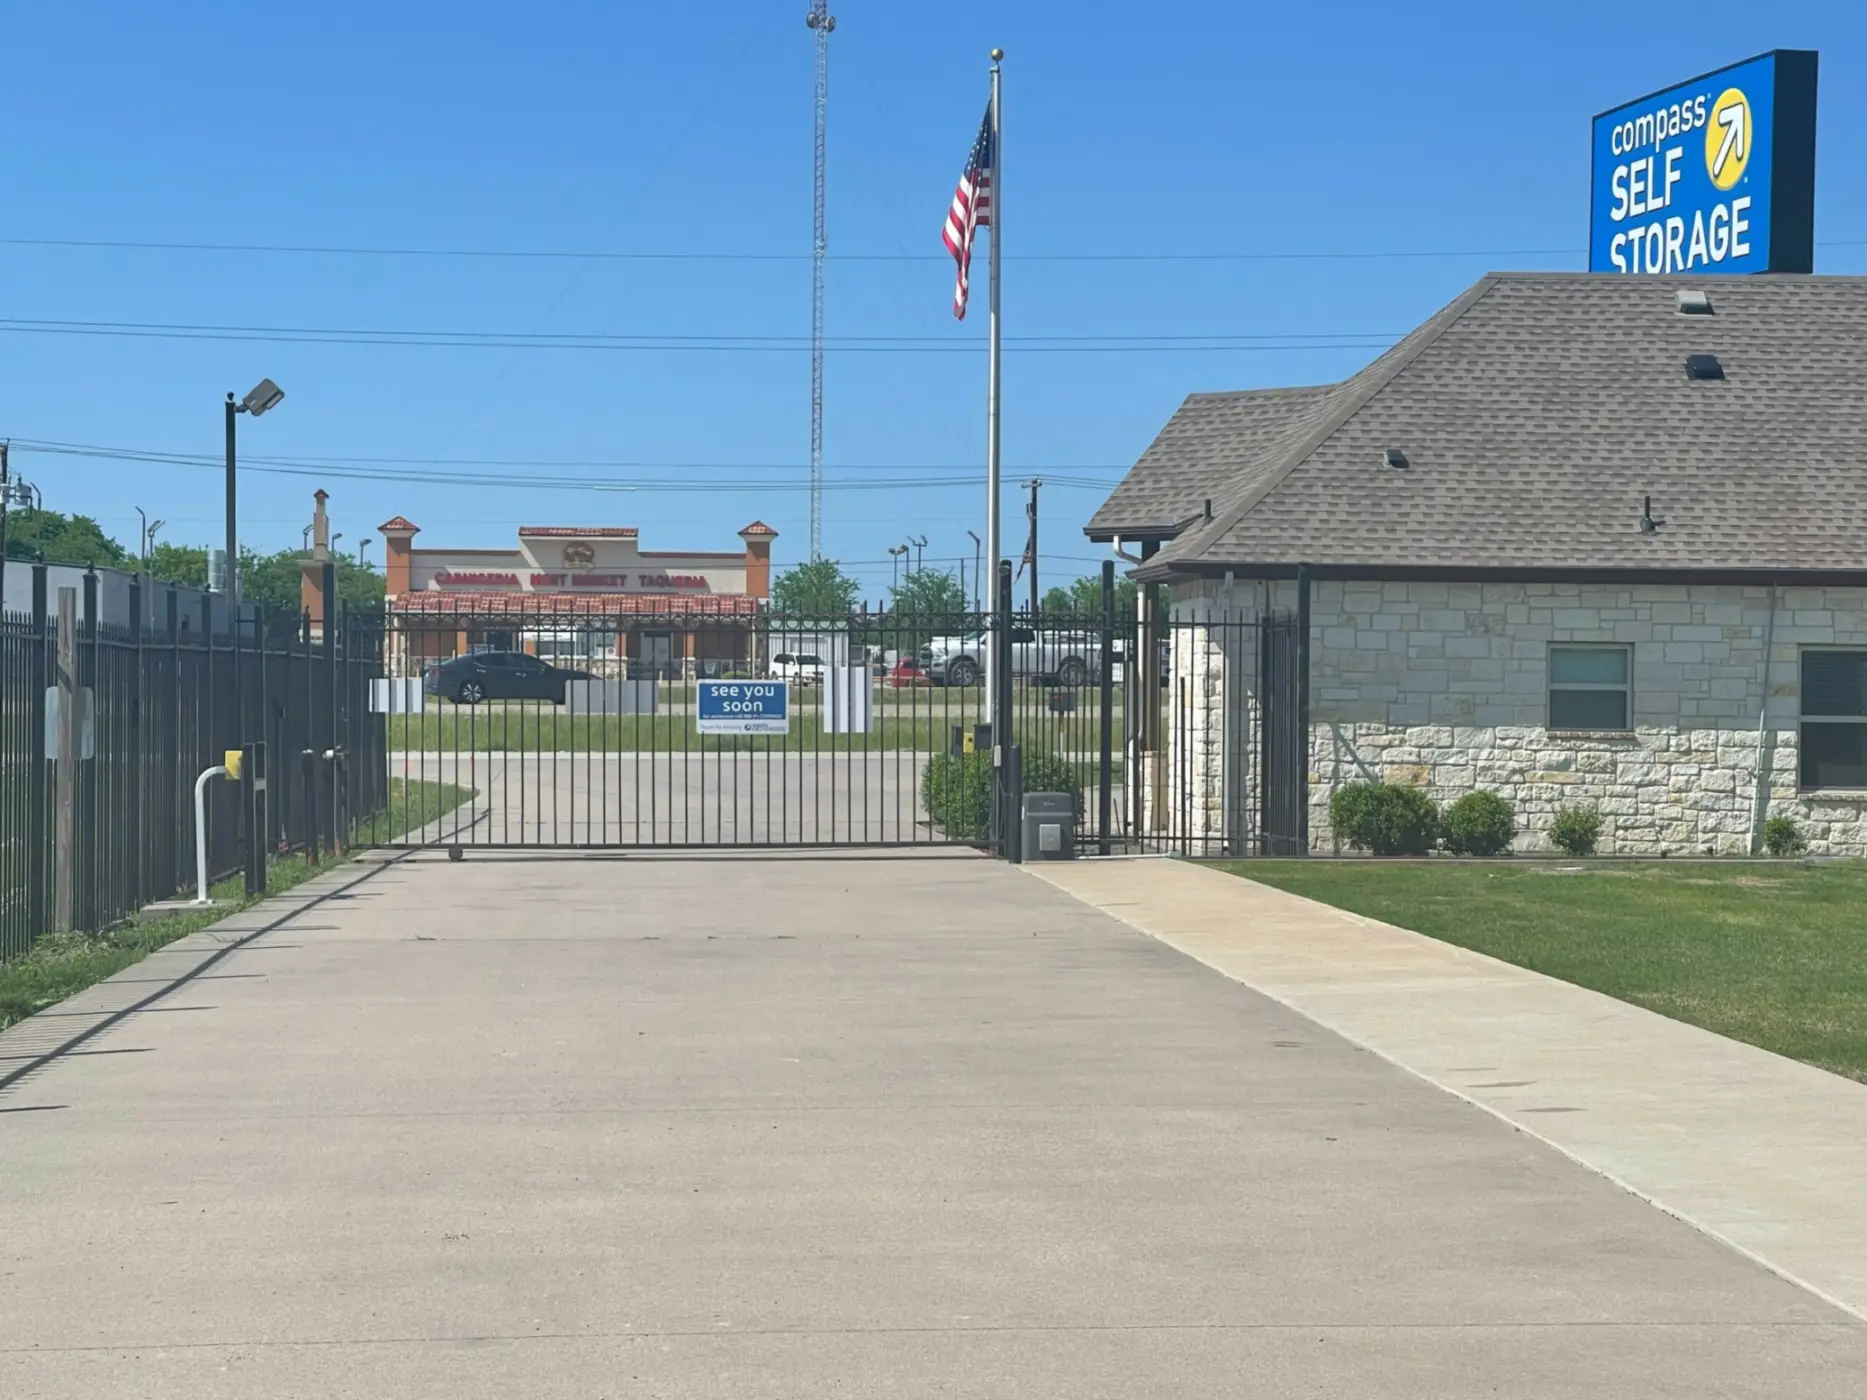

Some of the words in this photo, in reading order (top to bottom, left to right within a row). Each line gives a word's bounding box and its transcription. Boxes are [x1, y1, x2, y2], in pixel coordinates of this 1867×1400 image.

[1611, 95, 1706, 156] compass
[1610, 146, 1683, 222] SELF
[1610, 196, 1751, 274] STORAGE
[711, 685, 739, 697] see
[743, 685, 775, 700] you
[722, 701, 763, 713] soon
